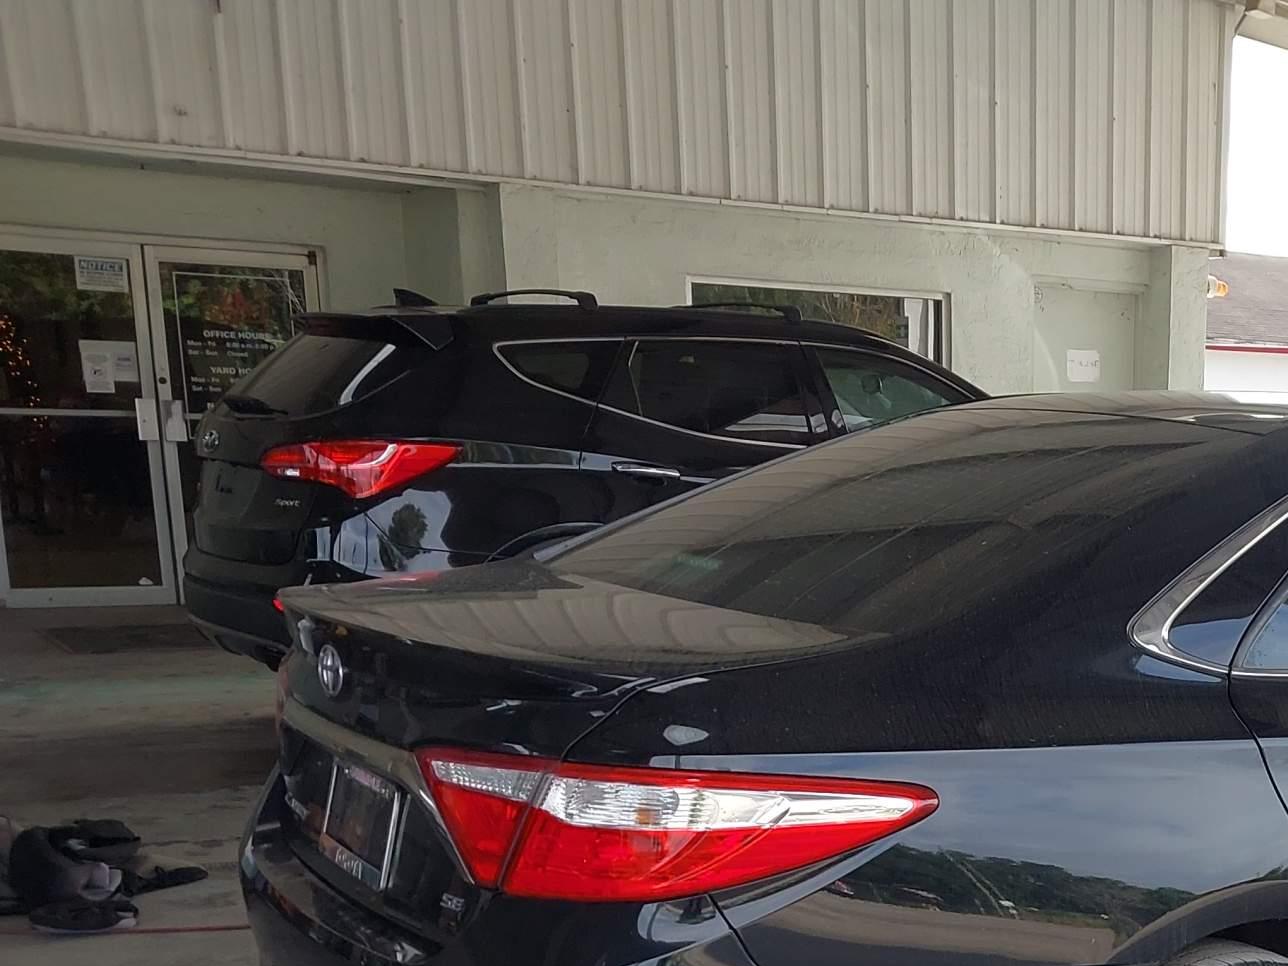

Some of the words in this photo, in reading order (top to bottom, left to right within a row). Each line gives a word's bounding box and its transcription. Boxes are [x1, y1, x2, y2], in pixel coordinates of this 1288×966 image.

[203, 330, 236, 338] OFFICE
[210, 366, 236, 375] YARD
[440, 893, 464, 911] SE
